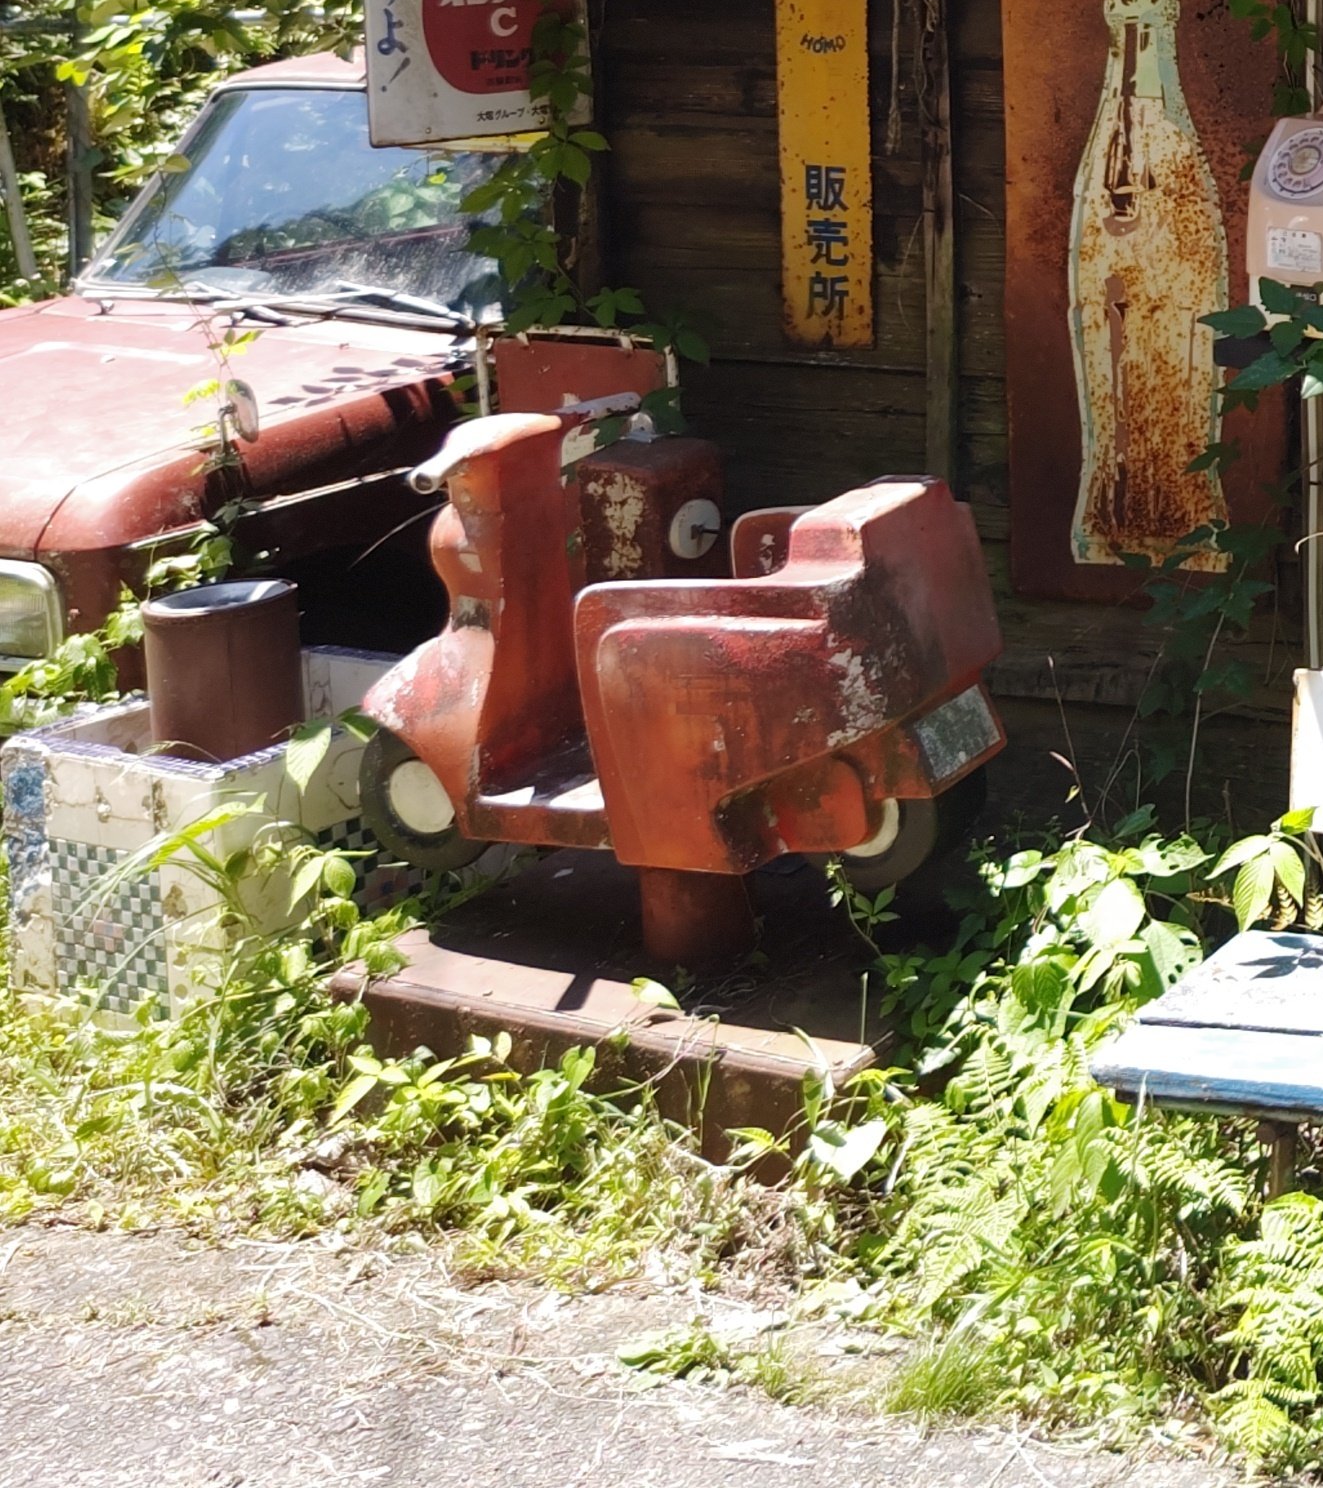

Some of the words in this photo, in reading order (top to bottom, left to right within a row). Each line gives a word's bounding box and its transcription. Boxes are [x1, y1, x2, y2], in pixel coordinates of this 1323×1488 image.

[490, 6, 519, 38] C
[805, 164, 851, 322] 販売所
